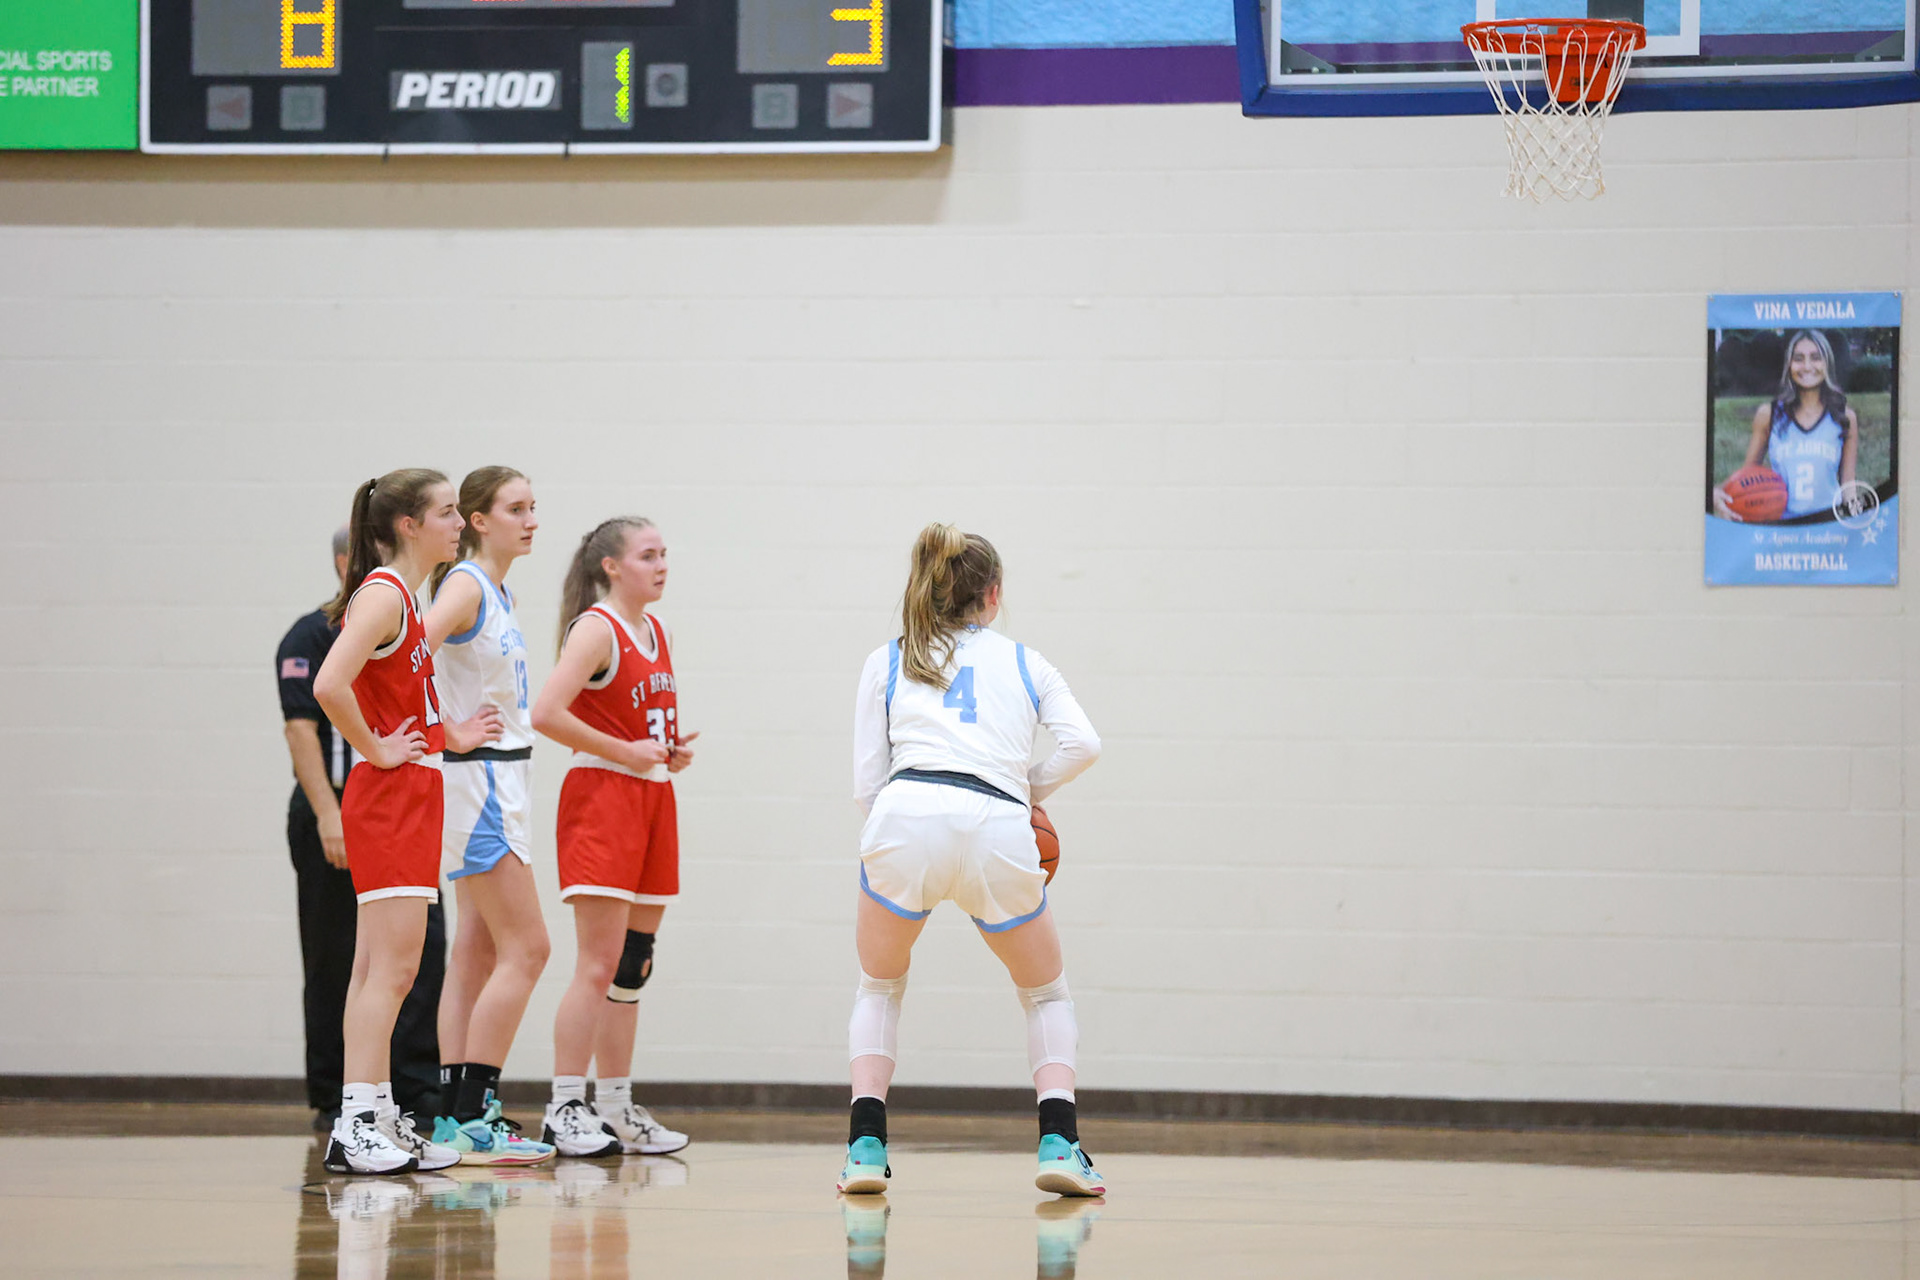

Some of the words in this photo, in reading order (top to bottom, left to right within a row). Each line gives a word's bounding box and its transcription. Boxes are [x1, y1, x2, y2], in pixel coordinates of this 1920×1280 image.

[36, 50, 113, 71] SPORTS
[12, 76, 99, 97] PARTNER
[396, 71, 556, 109] PERIOD
[614, 45, 631, 123] 1
[1754, 301, 1791, 320] VINA
[1795, 300, 1856, 319] VEDALA
[1795, 462, 1815, 501] 2
[1755, 553, 1848, 571] BASKETBALL
[631, 680, 647, 710] ST
[943, 666, 977, 724] 4
